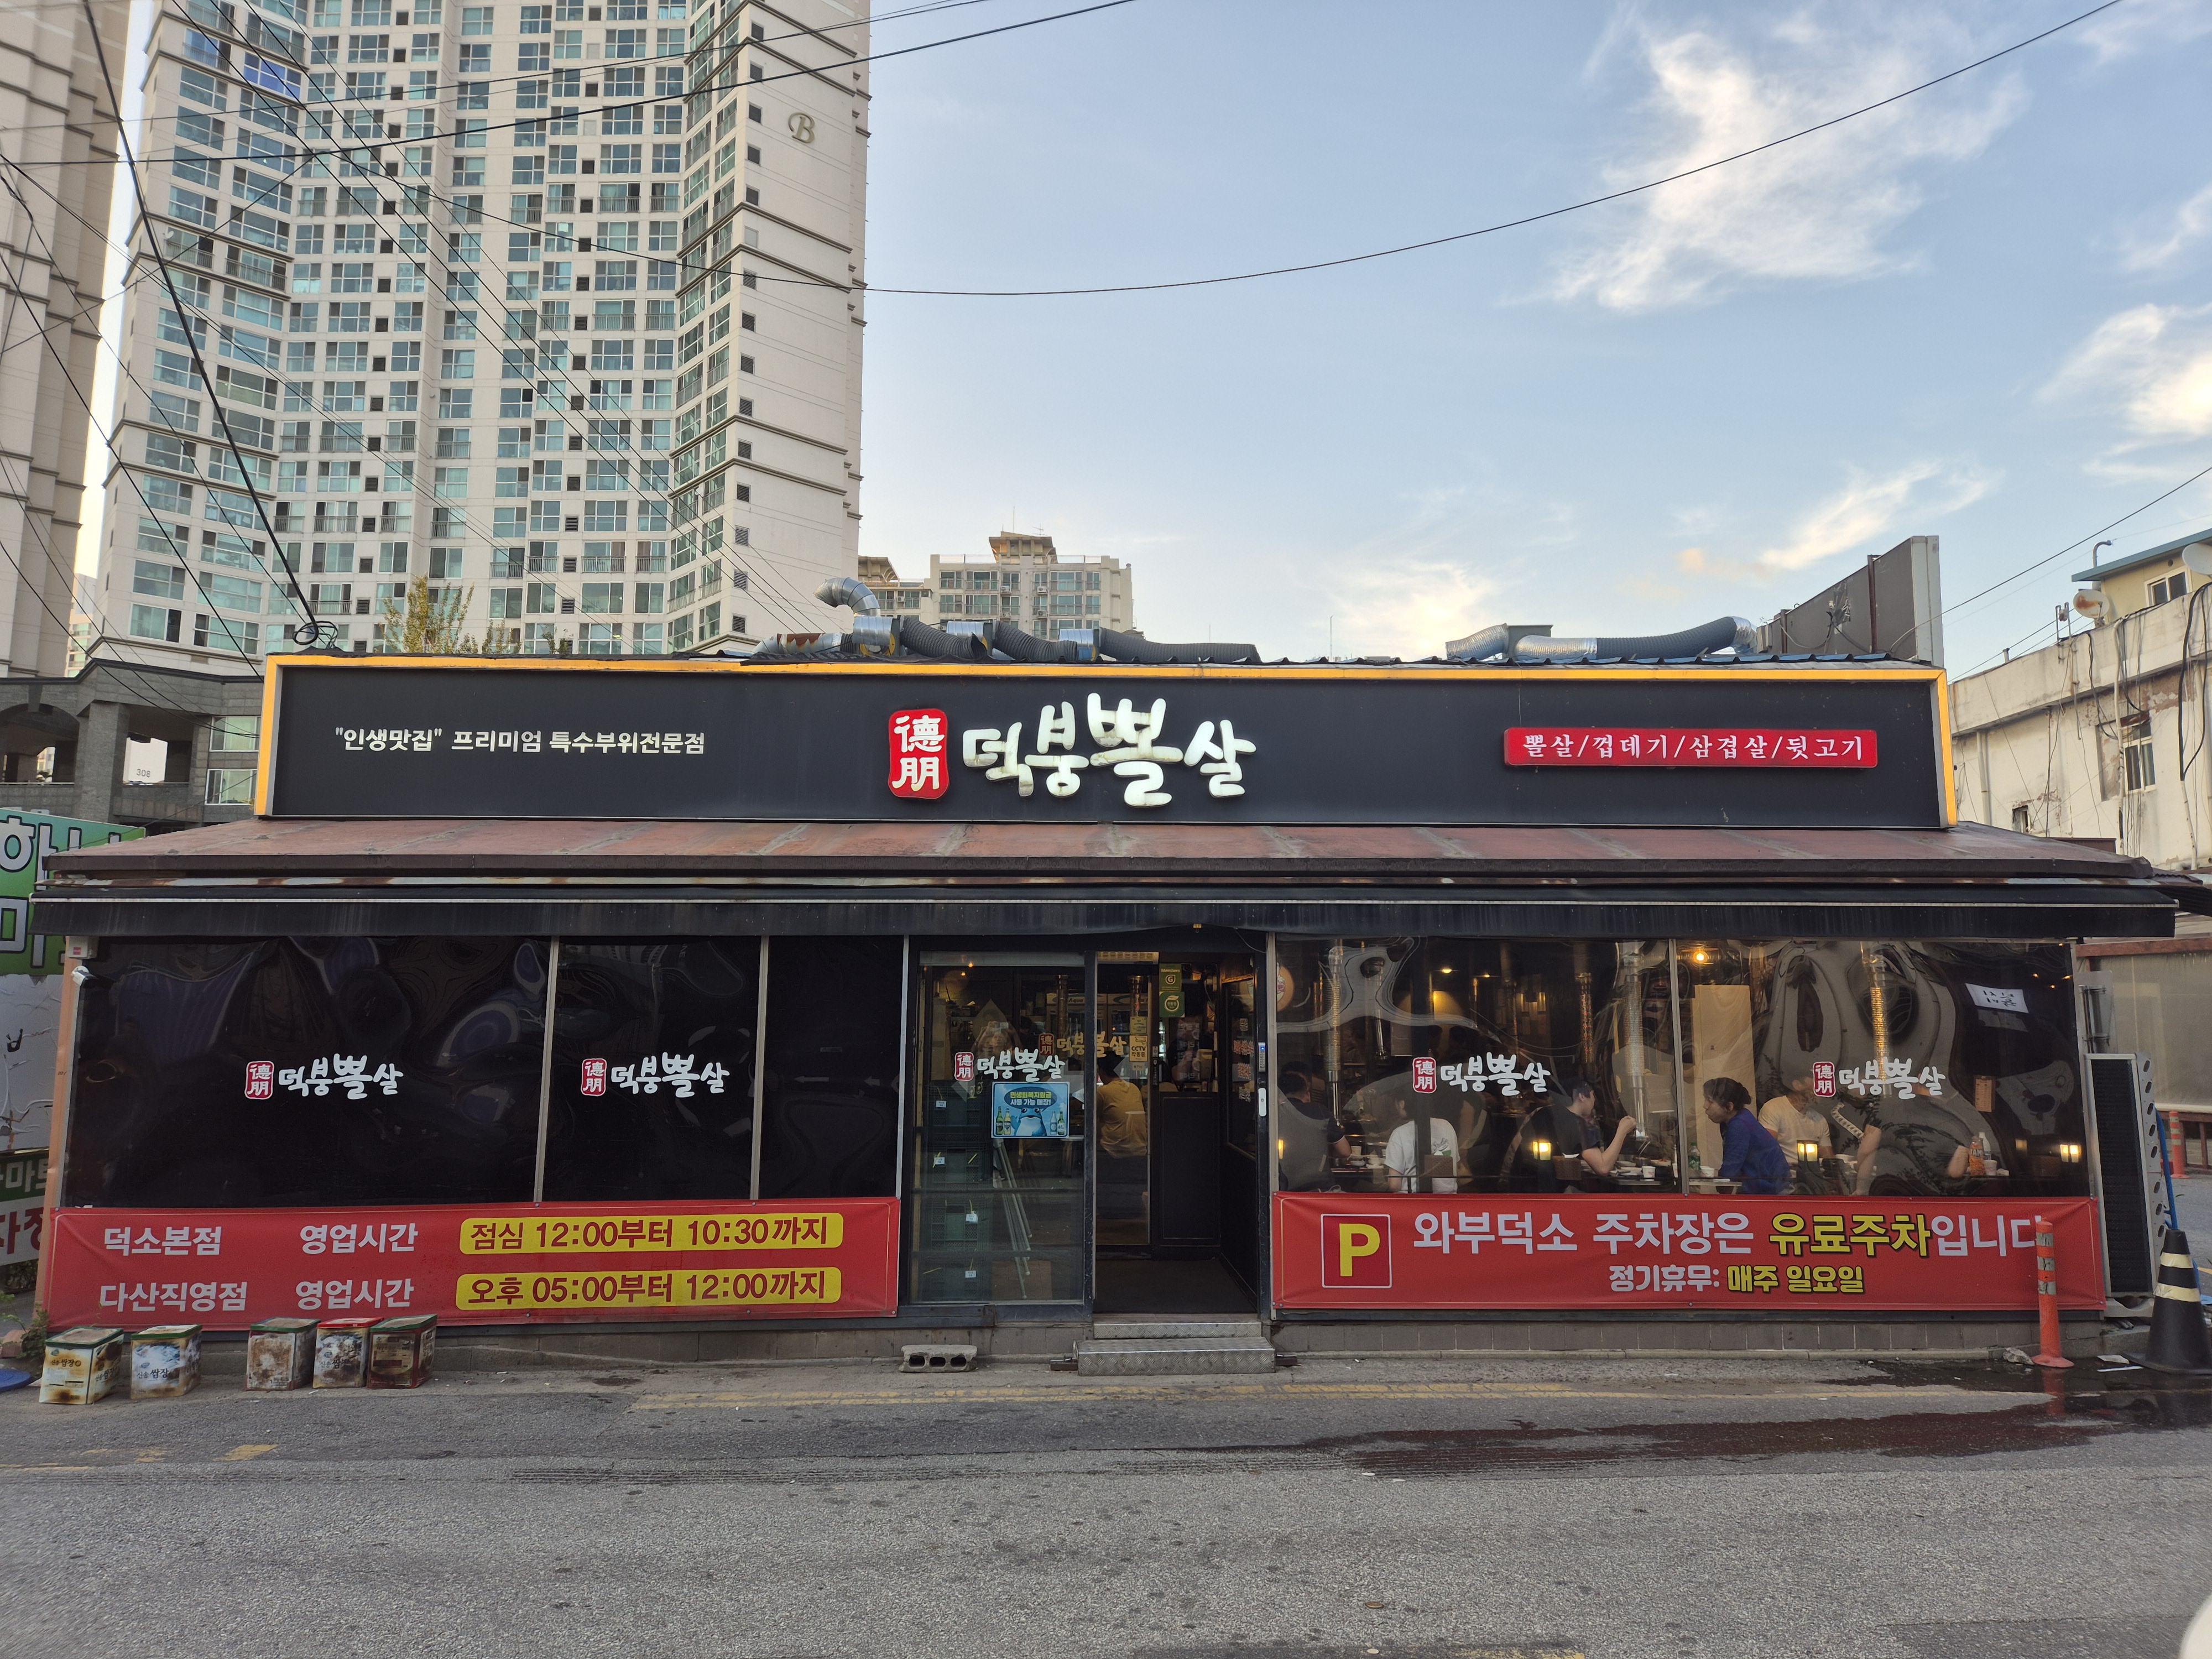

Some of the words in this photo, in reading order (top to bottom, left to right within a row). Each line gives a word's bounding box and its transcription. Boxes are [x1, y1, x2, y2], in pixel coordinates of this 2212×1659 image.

[335, 727, 442, 751] "인생맛집"
[451, 730, 542, 753] 프리미엄
[549, 732, 705, 755] 특수부위전문점
[893, 715, 945, 790] 德朋
[962, 692, 1256, 808] 덕붕뽈살
[136, 768, 150, 778] 308
[247, 1063, 272, 1095] 德朋
[279, 1053, 404, 1099] 덕붕뽈살
[583, 1061, 604, 1092] 德朋
[611, 1052, 730, 1098] 덕붕뽈살
[956, 1055, 972, 1078] 德朋
[977, 1047, 1065, 1082] 덕붕뽈살
[1415, 1060, 1435, 1089] 德朋
[1441, 1052, 1551, 1096] 덕붕뽈살
[1815, 1064, 1833, 1094] 德朋
[1839, 1057, 1945, 1099] 덕붕뽈살
[104, 1227, 222, 1256] 덕소본점
[300, 1223, 418, 1254] 영업시간
[470, 1222, 523, 1250] 점심
[536, 1219, 672, 1248] 12:00부터
[688, 1217, 827, 1246] 10:30까지
[1413, 1212, 1578, 1254] 와부덕소
[1593, 1212, 1754, 1255] 주차장은
[1339, 1223, 1381, 1276] P
[295, 1279, 414, 1310] 영업시간
[468, 1277, 523, 1305] 오후
[532, 1274, 672, 1303] 05:00부터
[686, 1271, 825, 1300] 12:00까지
[1609, 1265, 1720, 1292] 정기휴무:
[1727, 1265, 1779, 1293] 매주
[1787, 1265, 1865, 1293] 일요일
[100, 1281, 247, 1311] 다산직영점
[61, 1359, 75, 1367] 쌈장
[150, 1368, 169, 1379] 쌈장
